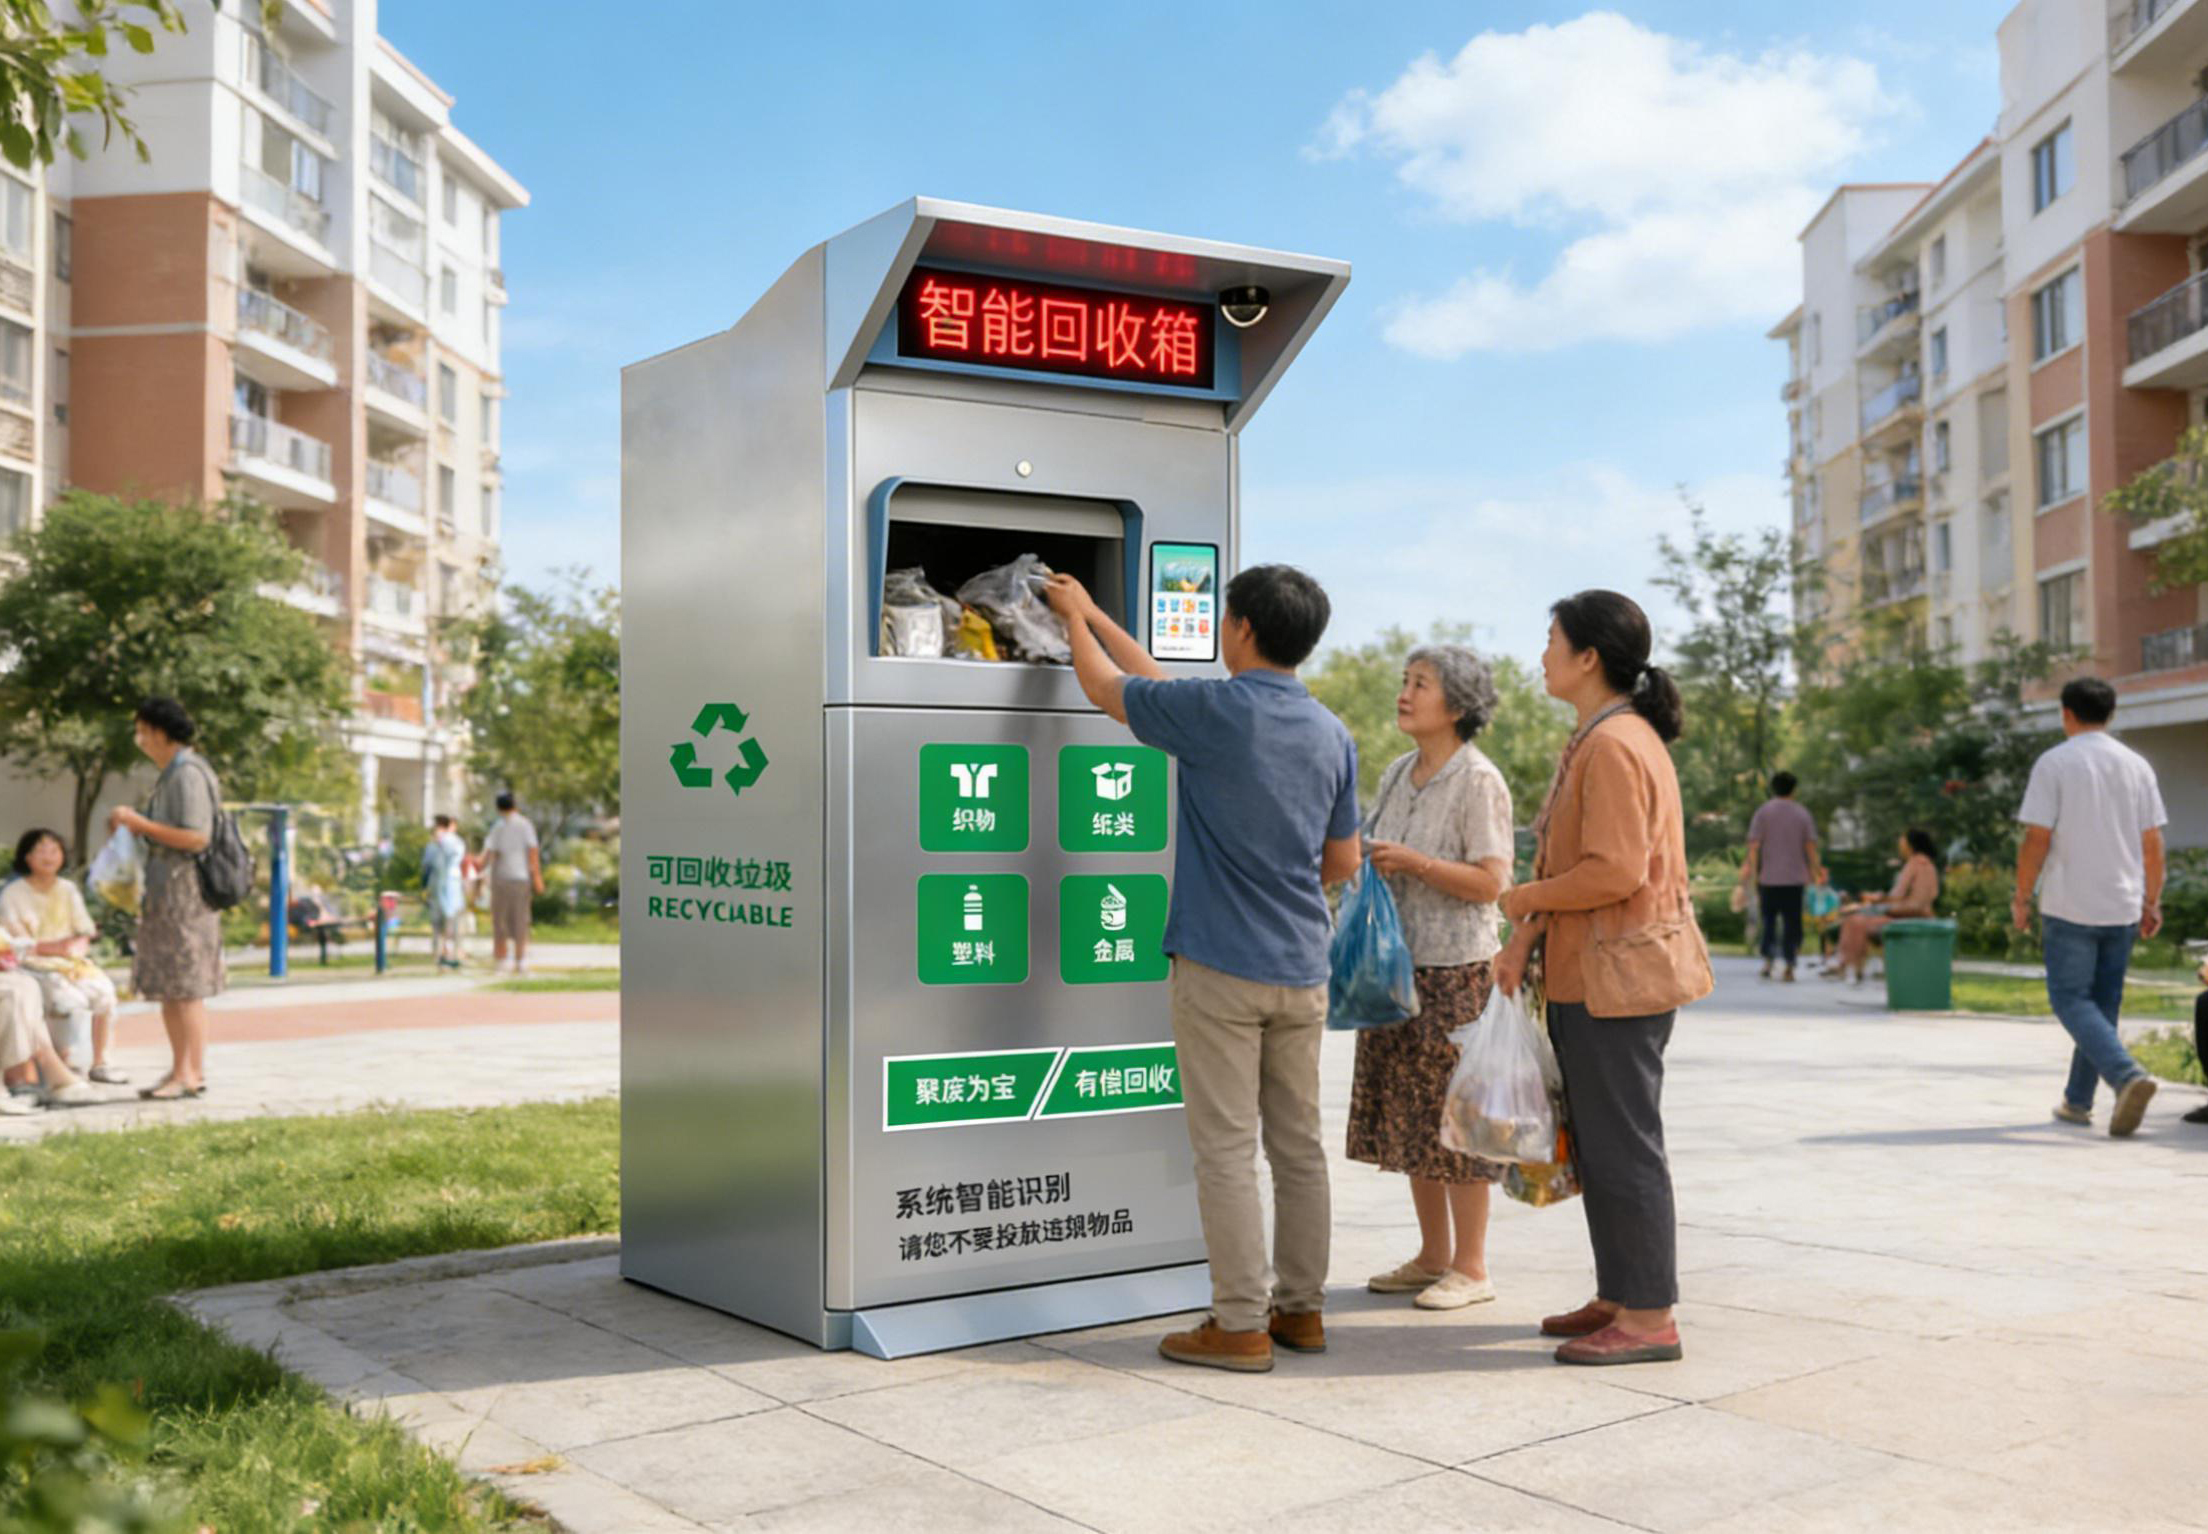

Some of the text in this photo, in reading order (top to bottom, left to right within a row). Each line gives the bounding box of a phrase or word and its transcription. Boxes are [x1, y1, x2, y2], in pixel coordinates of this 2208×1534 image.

[919, 279, 1198, 375] 智能回收箱
[953, 807, 997, 833] 织物
[1092, 811, 1135, 836] 纸类
[646, 855, 793, 892] 可回收垃圾
[1075, 1064, 1175, 1097] 有偿回收
[896, 1171, 1071, 1219] 系统智能识别
